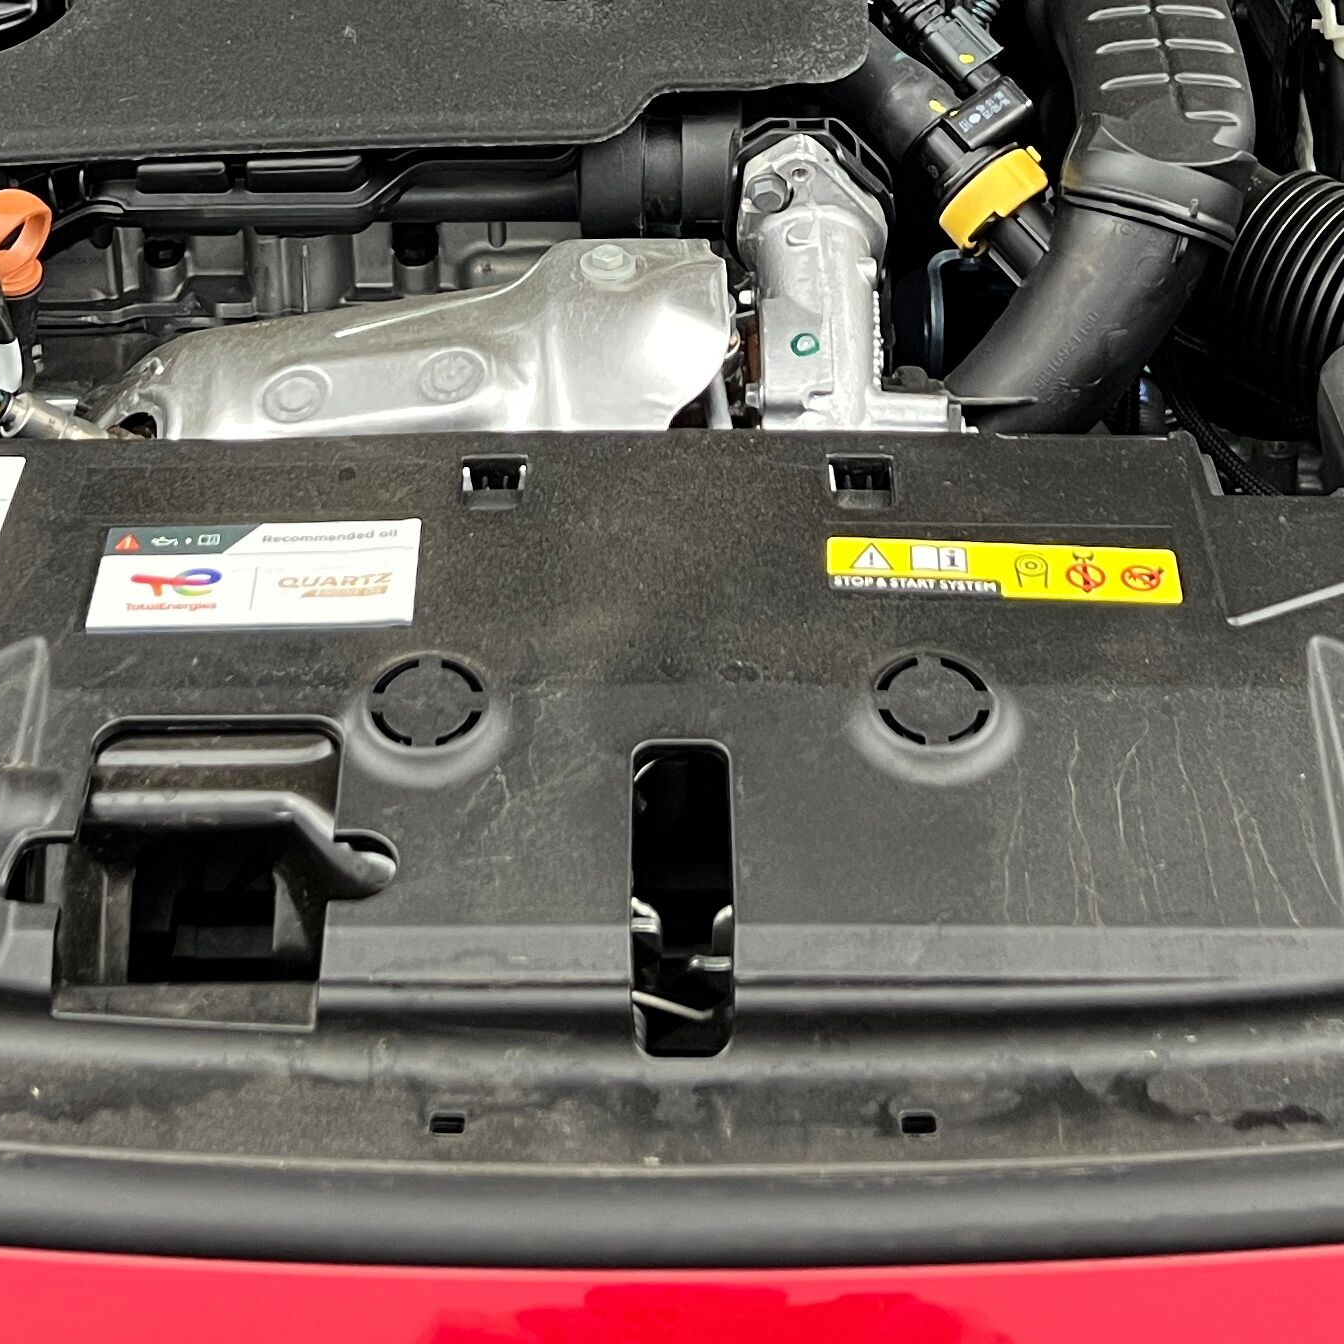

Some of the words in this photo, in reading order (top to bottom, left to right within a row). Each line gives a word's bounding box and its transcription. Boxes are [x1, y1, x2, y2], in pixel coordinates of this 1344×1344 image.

[262, 531, 375, 543] Recommended
[378, 529, 398, 538] oil
[277, 571, 393, 589] QUARTZ
[834, 575, 875, 587] STOP
[876, 576, 888, 588] &
[889, 577, 936, 590] START
[939, 579, 997, 593] SYSTEM
[125, 601, 217, 612] TotalEnergies
